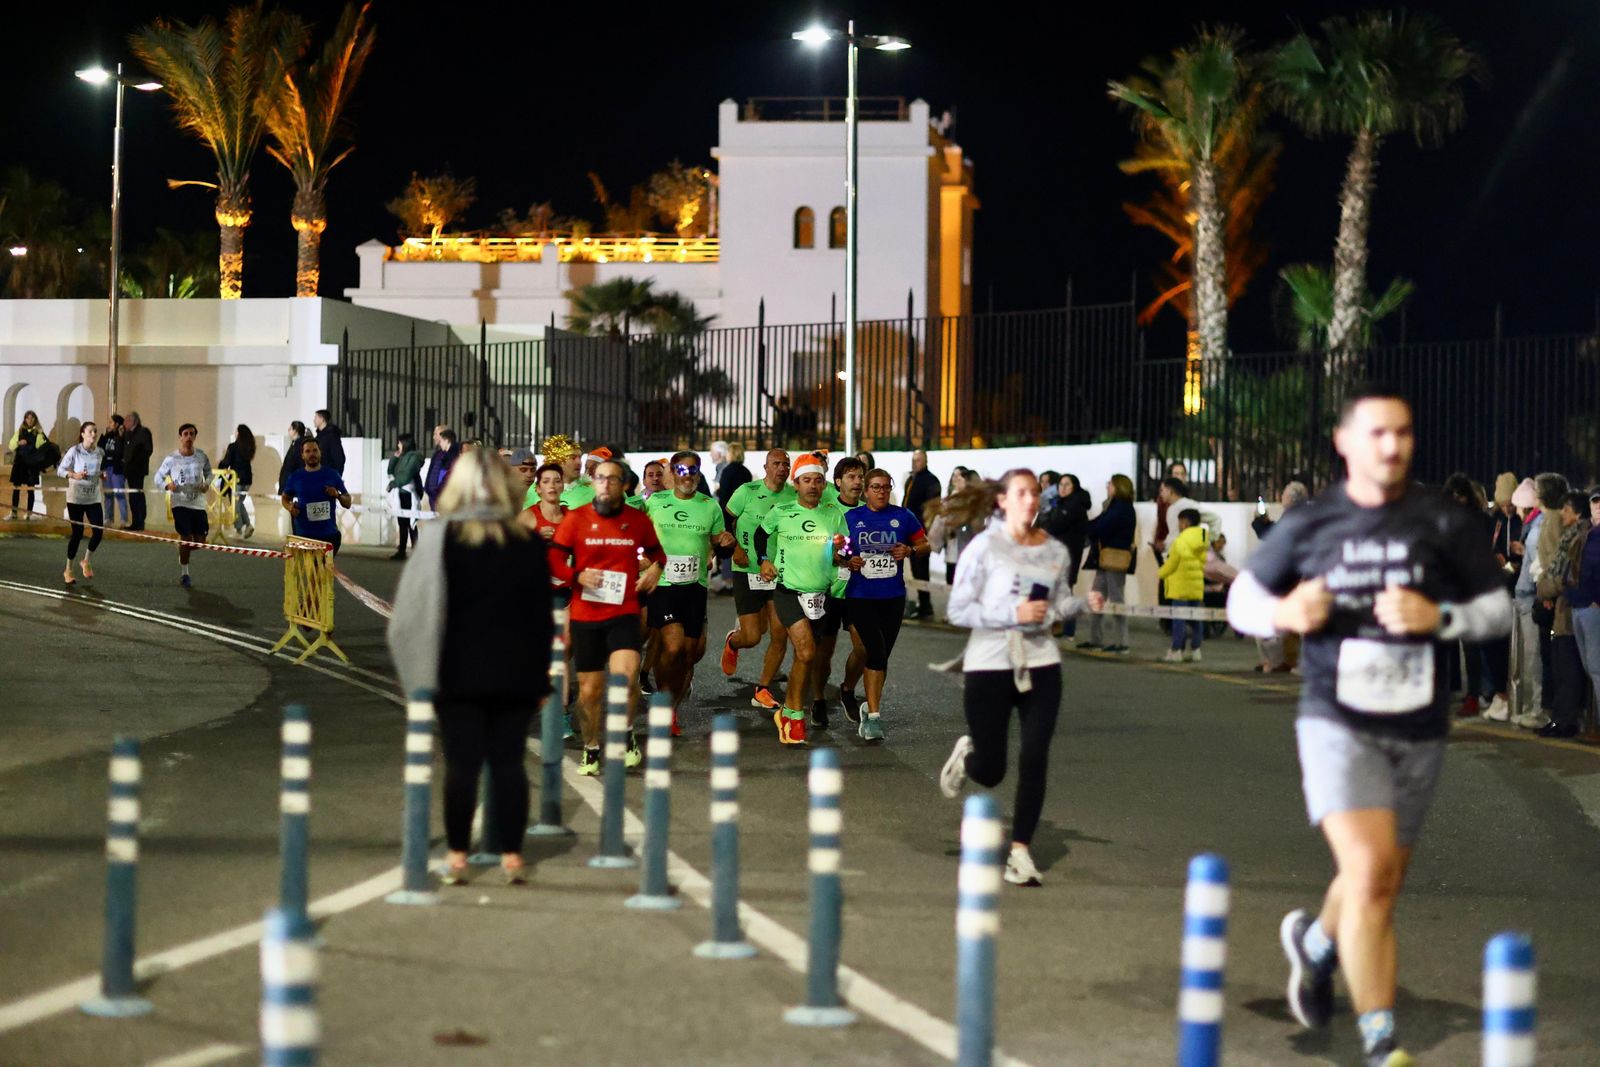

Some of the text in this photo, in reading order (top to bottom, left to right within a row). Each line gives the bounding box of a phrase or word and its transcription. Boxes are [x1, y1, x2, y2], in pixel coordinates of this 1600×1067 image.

[806, 535, 832, 543] energa
[859, 531, 897, 545] RCM
[673, 563, 692, 573] 321
[870, 558, 889, 569] 342
